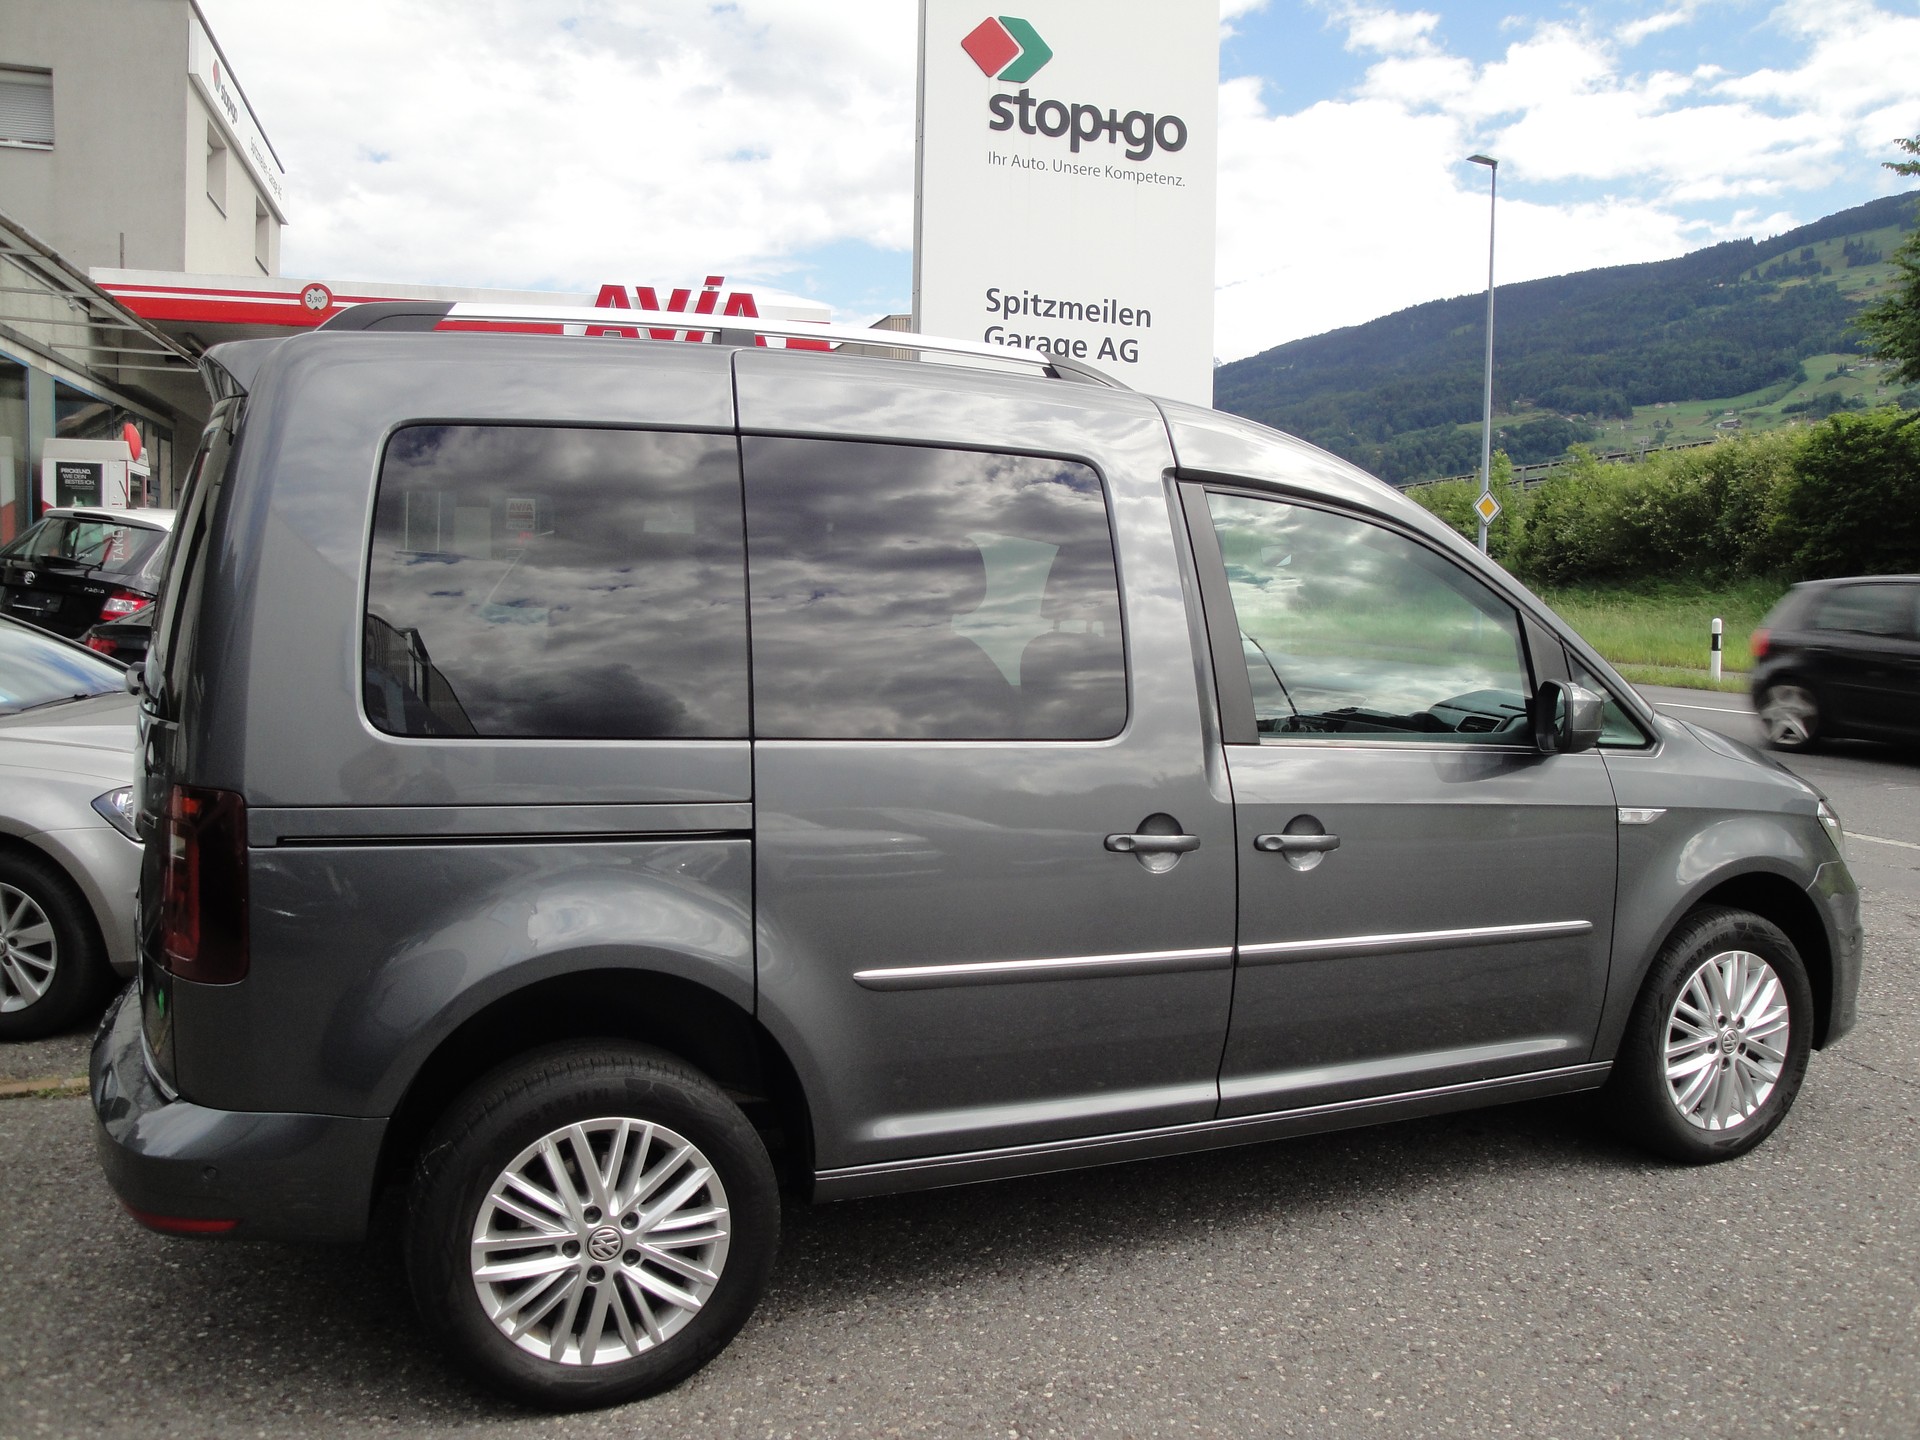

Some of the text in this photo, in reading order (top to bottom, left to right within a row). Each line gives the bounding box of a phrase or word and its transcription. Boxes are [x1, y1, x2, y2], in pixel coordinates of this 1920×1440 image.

[989, 88, 1188, 162] stop+go
[988, 151, 1186, 187] Ihr Auto. Unsere Kompetenz.
[985, 287, 1151, 328] Spitzmeilen
[1096, 336, 1139, 363] AG
